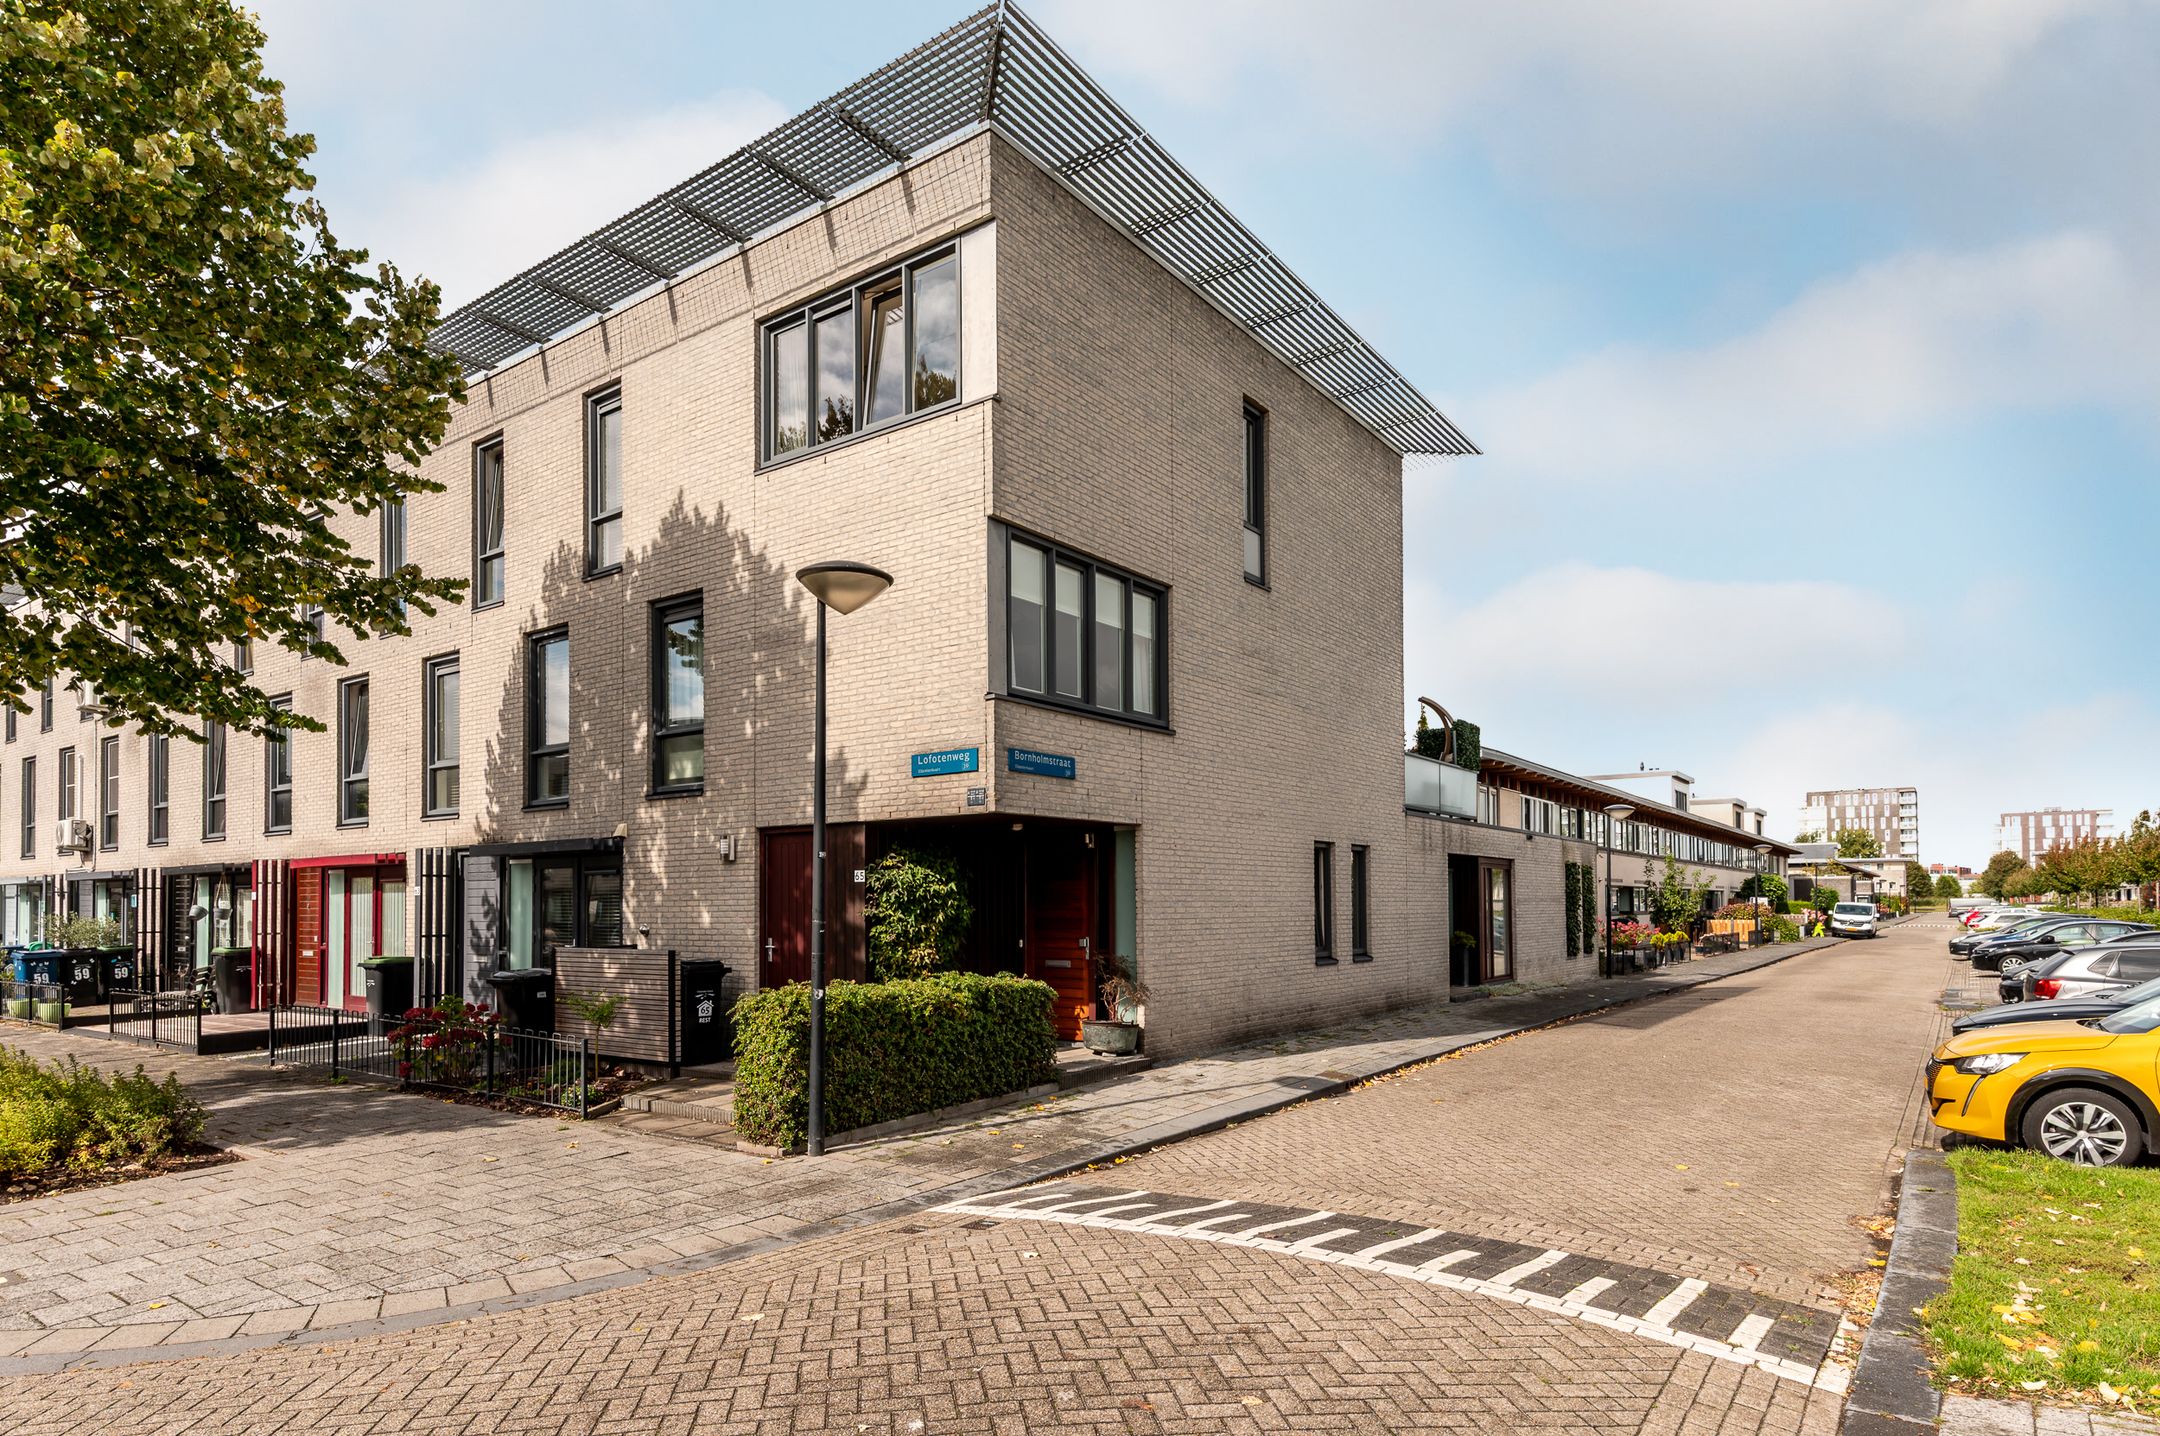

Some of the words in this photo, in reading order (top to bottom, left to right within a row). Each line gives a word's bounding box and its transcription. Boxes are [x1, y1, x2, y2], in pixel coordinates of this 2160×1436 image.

[917, 752, 970, 765] Lofotenweg
[1014, 750, 1071, 768] Bornholmstraat
[855, 872, 864, 880] 65
[33, 973, 49, 984] 59
[74, 968, 90, 980] 59
[114, 967, 128, 979] 59
[700, 1006, 710, 1014] 65
